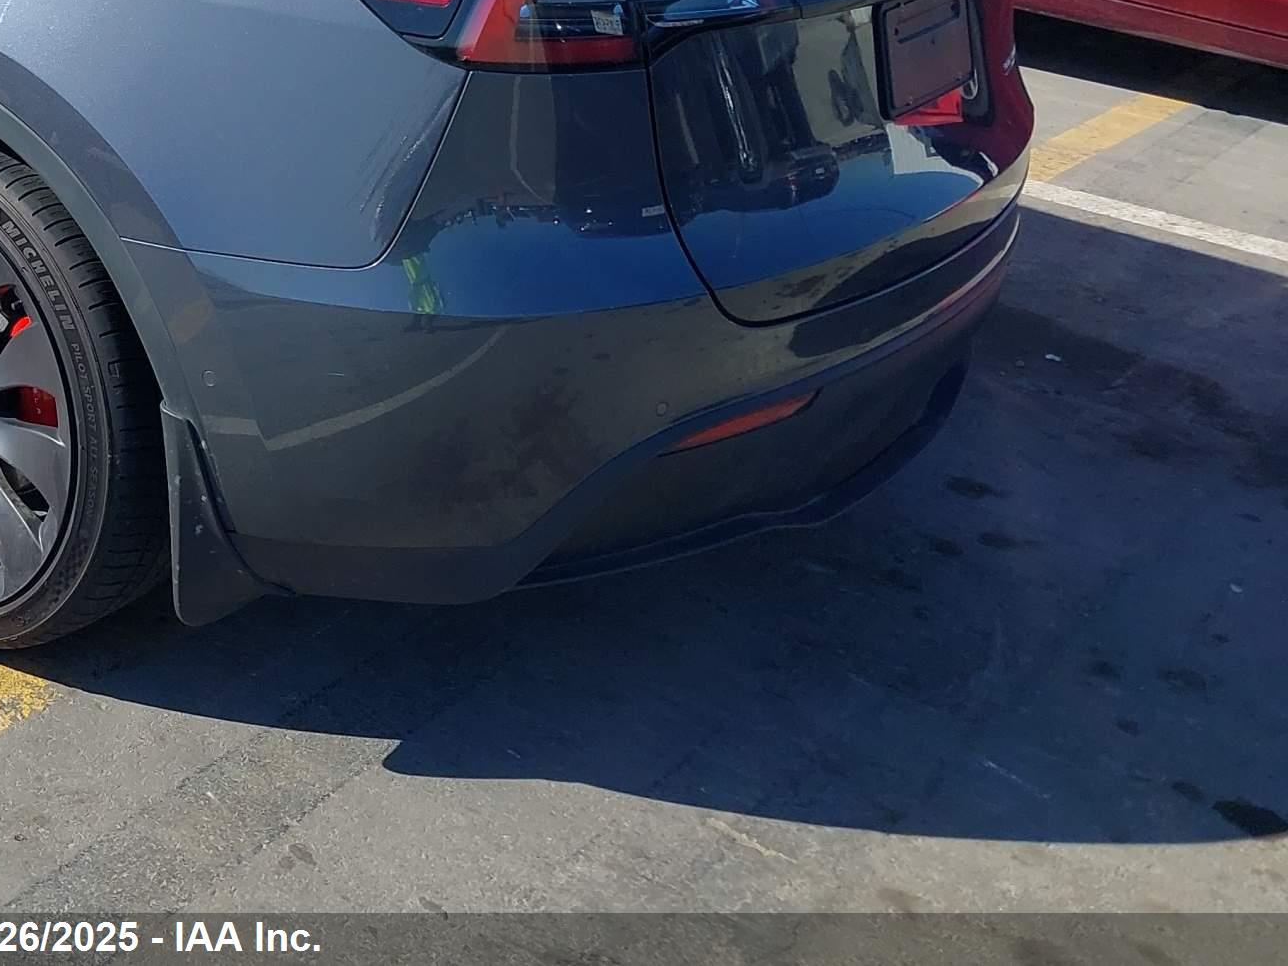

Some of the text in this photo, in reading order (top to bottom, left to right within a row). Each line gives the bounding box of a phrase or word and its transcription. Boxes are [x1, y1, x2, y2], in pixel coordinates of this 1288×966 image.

[2, 220, 76, 331] MICHELIN
[71, 343, 88, 379] PILOT
[84, 385, 97, 432] SPORT
